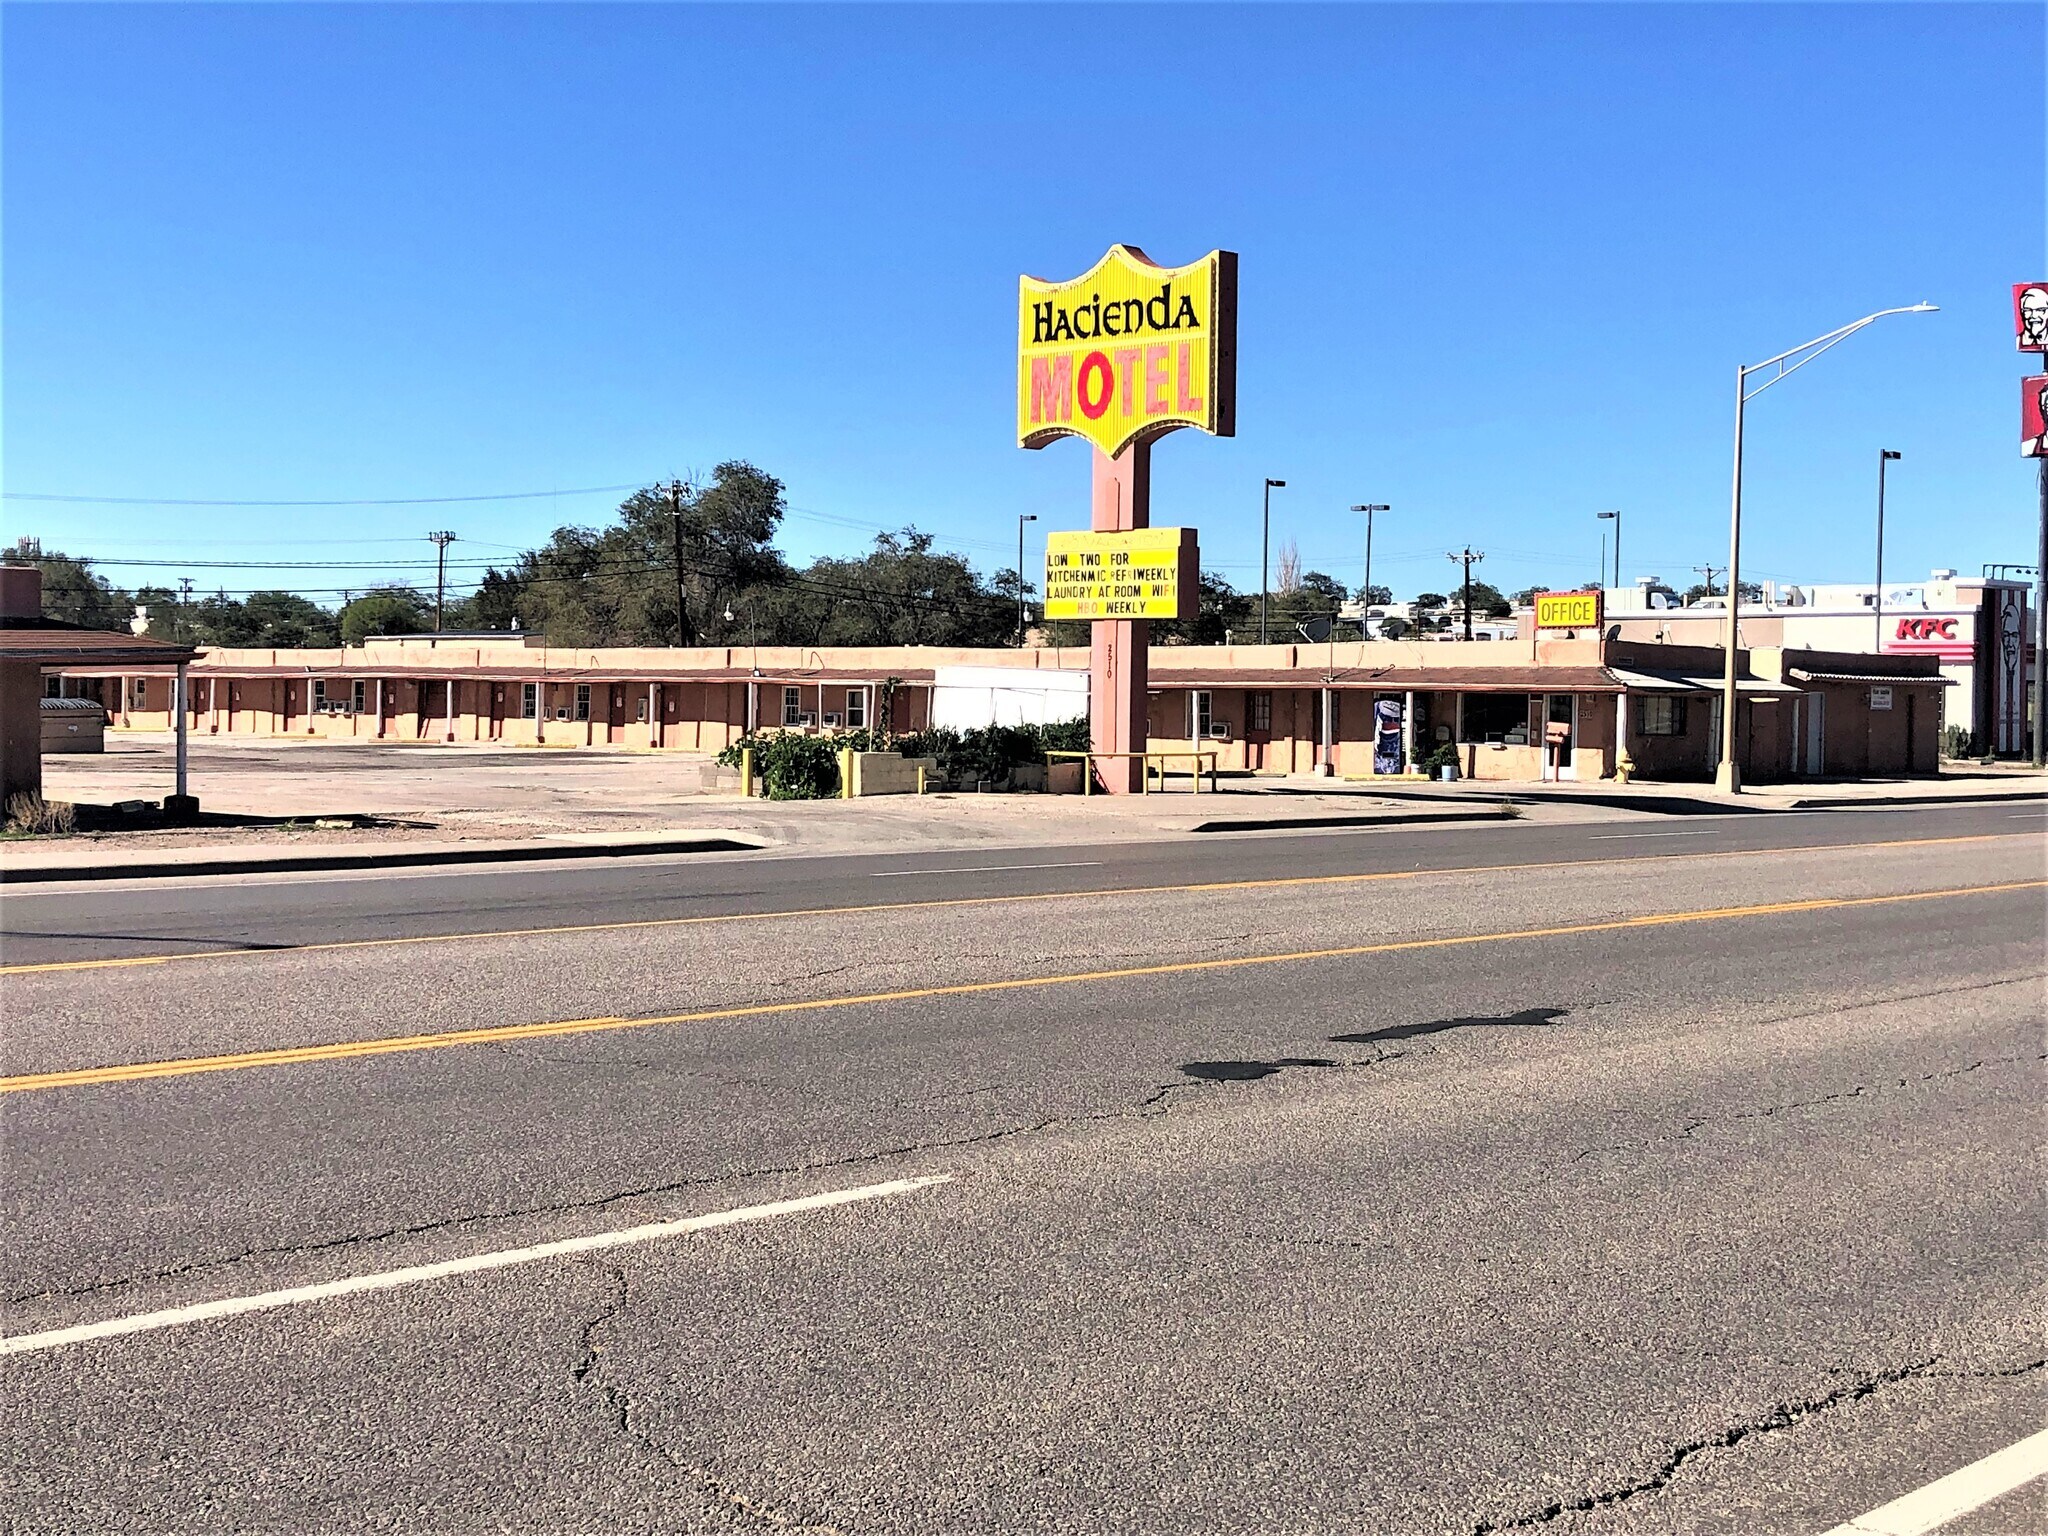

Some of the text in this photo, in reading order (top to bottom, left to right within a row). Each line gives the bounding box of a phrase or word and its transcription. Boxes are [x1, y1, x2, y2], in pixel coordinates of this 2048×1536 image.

[1030, 342, 1204, 424] MOTEL
[1047, 552, 1130, 567] LOW TWO FOR
[1046, 585, 1093, 599] LAUNDRY
[1114, 584, 1141, 598] ROOM
[1077, 601, 1147, 614] HBO WEEKLY
[1541, 601, 1591, 622] OFFICE
[1896, 617, 1960, 640] KFC
